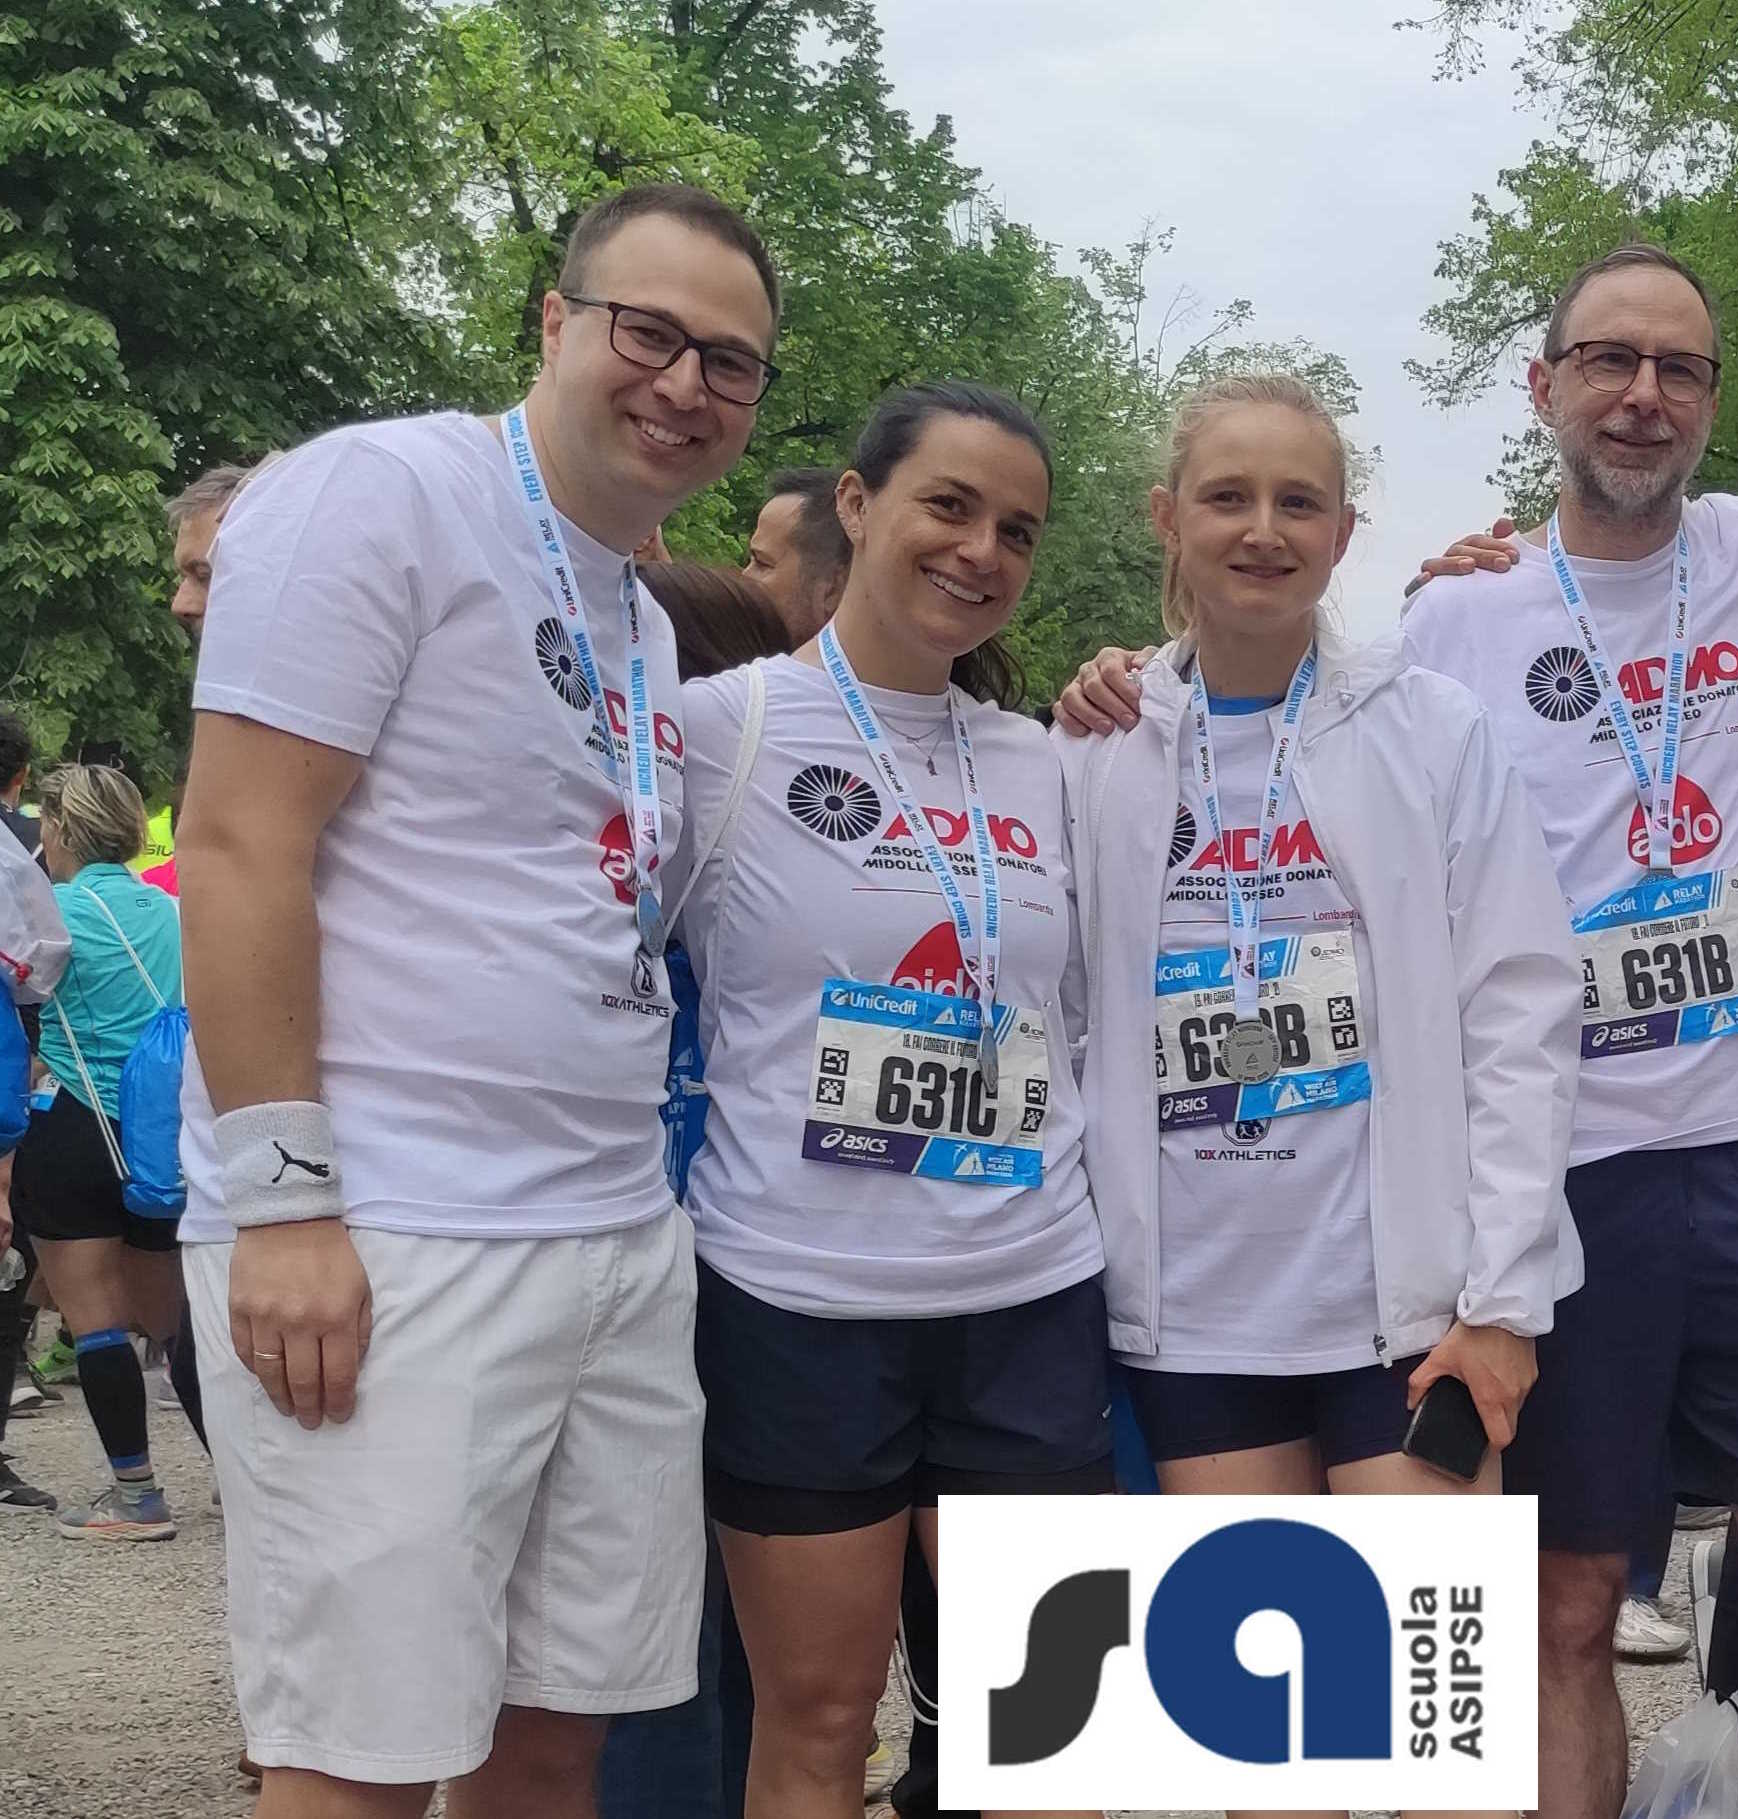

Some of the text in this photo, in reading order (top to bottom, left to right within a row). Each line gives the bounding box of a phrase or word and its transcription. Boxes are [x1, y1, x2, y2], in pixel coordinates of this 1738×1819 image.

[513, 438, 544, 502] EVERY STEP
[1555, 560, 1579, 606] MARATHON
[631, 658, 647, 711] MARATHON
[847, 685, 881, 742] MARATHON
[1661, 652, 1684, 784] UNICREDIT RELAY MARATHON
[1610, 700, 1652, 790] EVERY STEP COUNTS
[1188, 819, 1329, 872] ADM
[1631, 805, 1720, 858] ado
[925, 845, 972, 939] EVERY STEP COUNTS
[984, 888, 1000, 939] UNICREDIT
[1673, 884, 1705, 899] RELAY
[1621, 933, 1734, 1010] 631B
[850, 993, 918, 1016] UniCredit
[1610, 1023, 1648, 1042] asics
[875, 1055, 998, 1138] 631C
[1174, 1096, 1208, 1114] asics
[843, 1133, 889, 1153] asics
